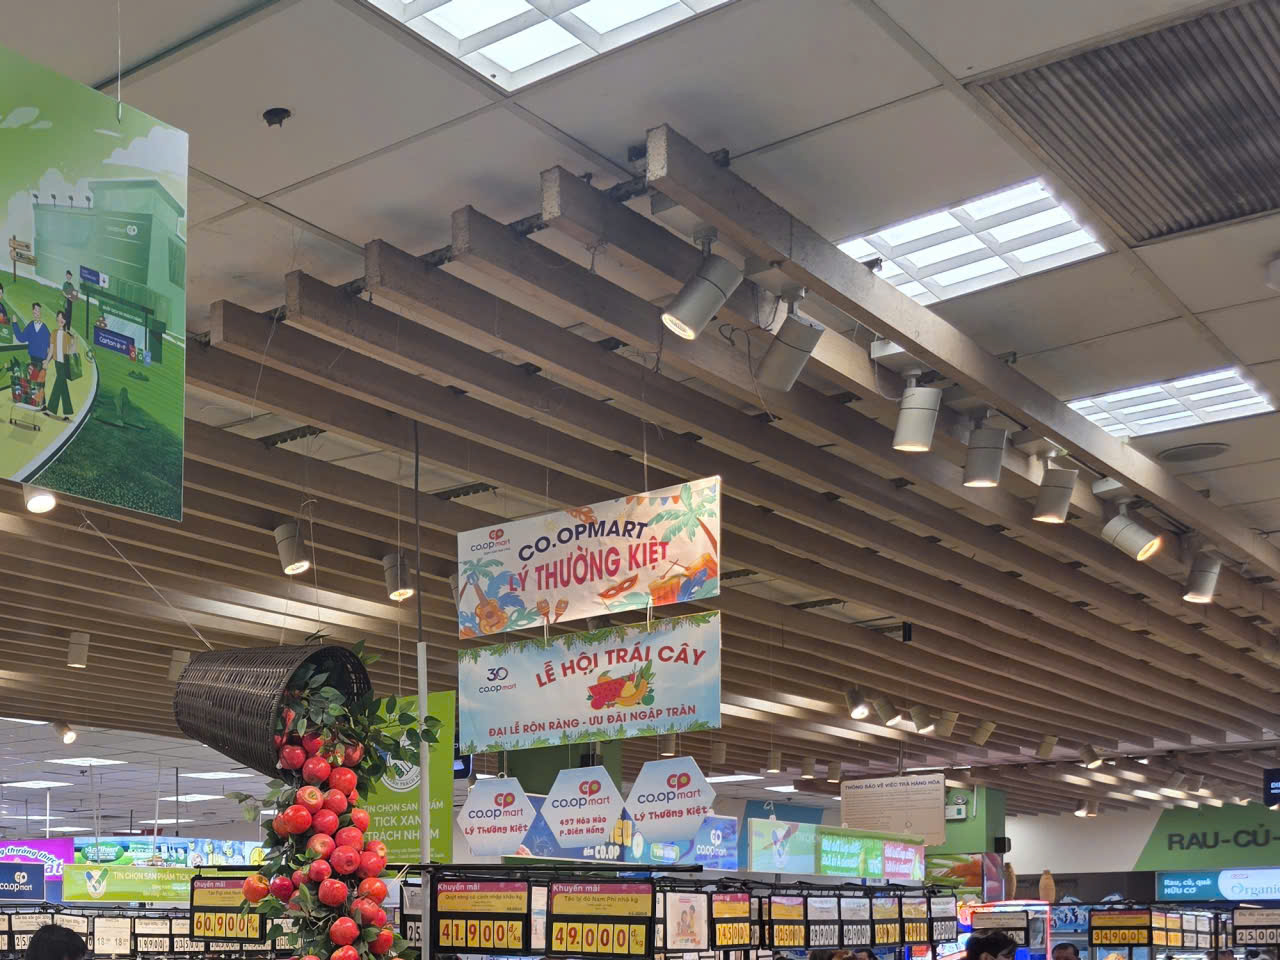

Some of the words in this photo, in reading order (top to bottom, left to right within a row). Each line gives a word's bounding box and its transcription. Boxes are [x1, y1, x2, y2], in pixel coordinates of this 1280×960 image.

[518, 520, 648, 561] CO.OPMART
[509, 564, 529, 592] LÝ
[535, 545, 620, 591] THƯỜNG
[628, 536, 669, 571] KIỆT
[536, 660, 557, 687] LỄ
[562, 651, 598, 676] HỘI
[604, 641, 651, 665] TRÁI
[657, 643, 706, 667] CÂY
[486, 667, 508, 682] 30
[489, 726, 507, 738] ĐẠI
[509, 720, 520, 735] LỄ
[523, 719, 545, 734] RỘN
[548, 717, 580, 731] RÀNG
[589, 713, 605, 726] ƯU
[607, 710, 626, 724] ĐÃI
[630, 707, 663, 722] NGẬP
[666, 704, 696, 718] TRÀN
[373, 816, 398, 827] TICK
[400, 814, 424, 826] XAN
[634, 812, 646, 822] Lý
[648, 807, 683, 821] Thường
[686, 804, 708, 817] Kiệt
[404, 828, 440, 841] NHM
[465, 825, 475, 837] Lý
[477, 823, 507, 836] Thường
[510, 822, 528, 834] Kiệt
[594, 845, 620, 860] CO.OP
[438, 882, 465, 892] Khuyến
[467, 882, 480, 891] mãi
[552, 883, 583, 893] Khuyến
[585, 884, 600, 892] mãi
[195, 916, 246, 933] 60.900
[442, 923, 505, 943] 41.900
[554, 926, 626, 947] 49.000
[1094, 931, 1137, 942] 34.900
